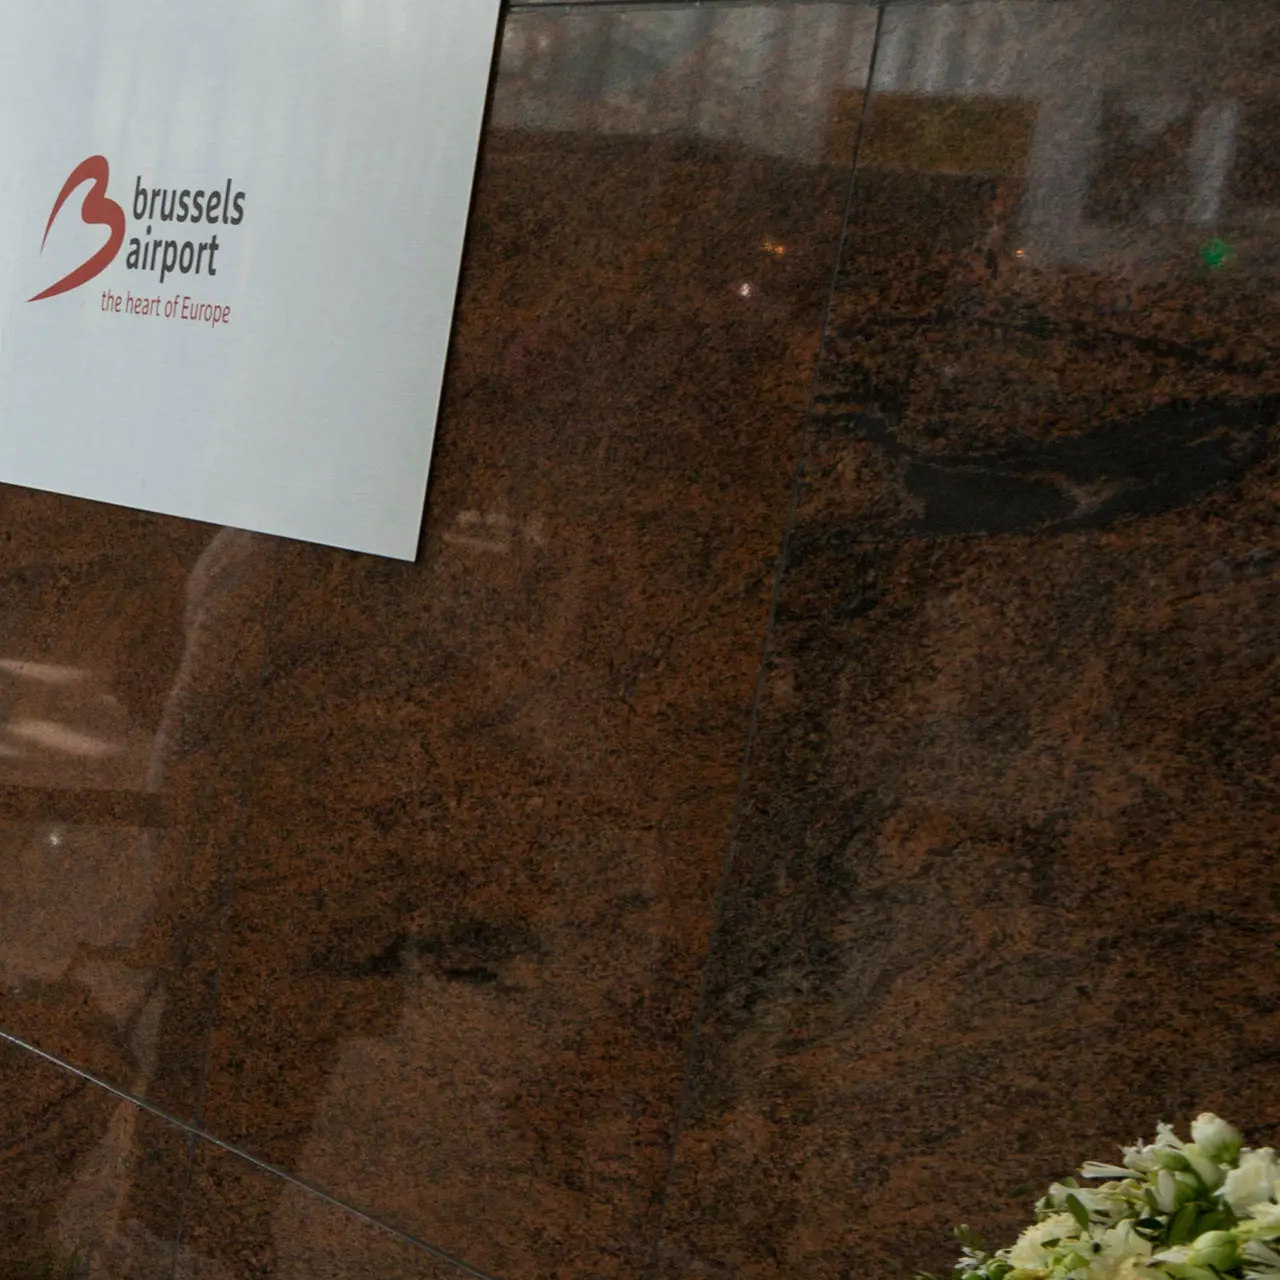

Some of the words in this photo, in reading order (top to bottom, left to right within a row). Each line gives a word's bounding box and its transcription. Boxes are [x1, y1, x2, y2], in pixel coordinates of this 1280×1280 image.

[132, 175, 246, 226] brussels
[126, 224, 220, 284] airport
[101, 289, 122, 313] the
[125, 291, 161, 318] heart
[163, 294, 180, 318] of
[181, 296, 231, 329] Europe
